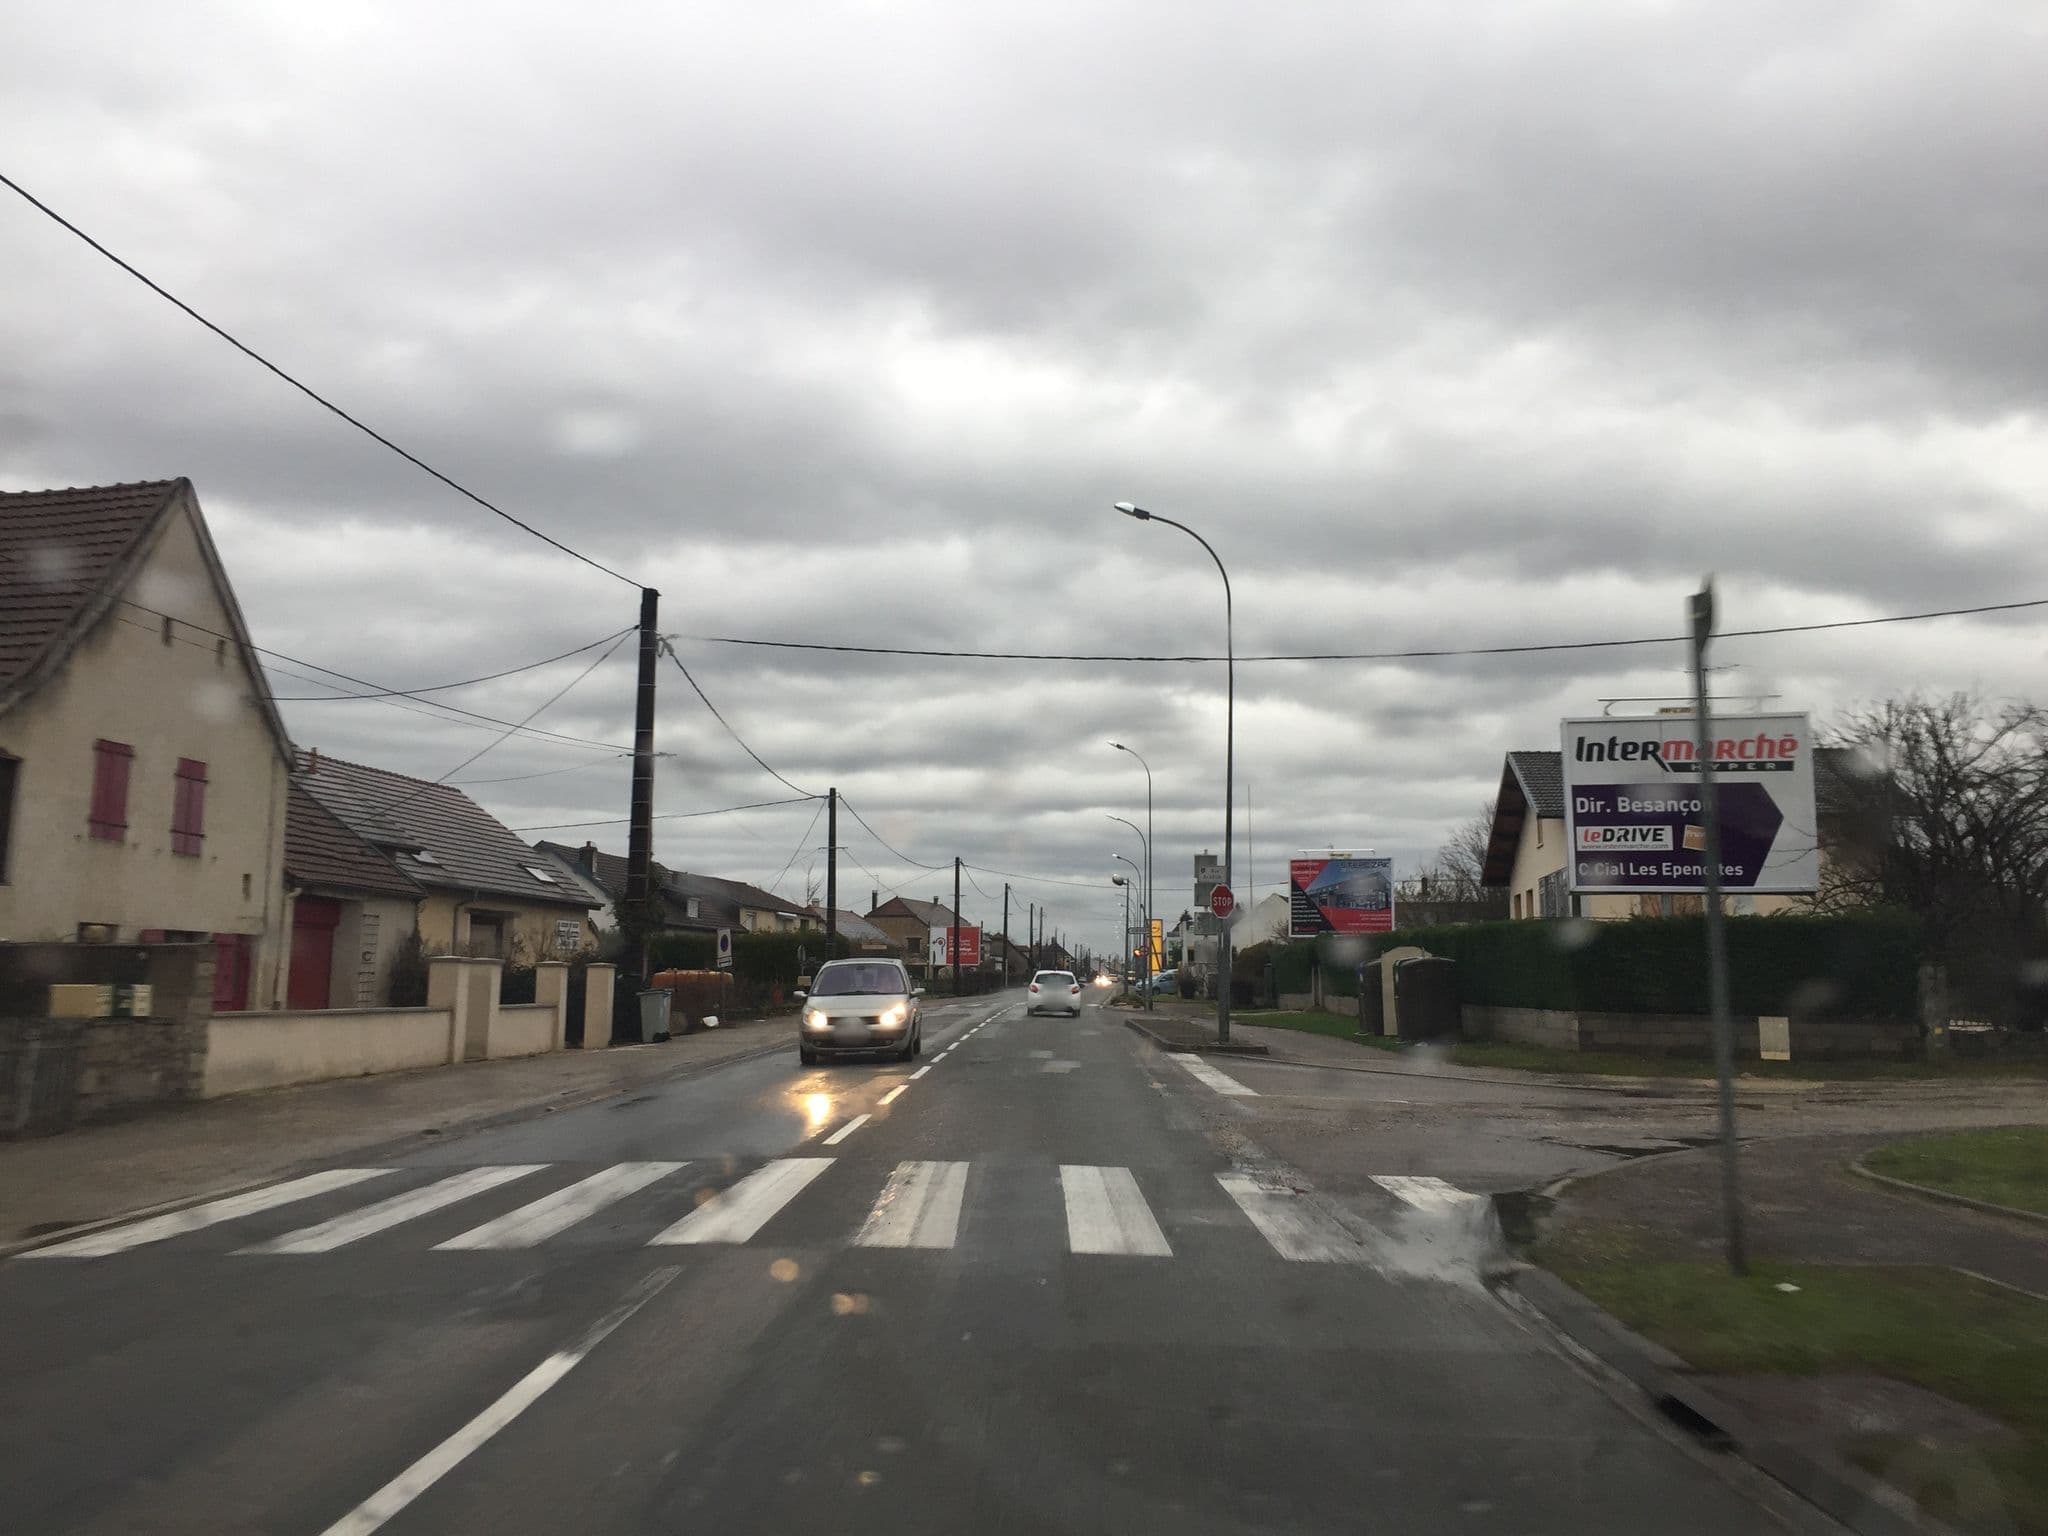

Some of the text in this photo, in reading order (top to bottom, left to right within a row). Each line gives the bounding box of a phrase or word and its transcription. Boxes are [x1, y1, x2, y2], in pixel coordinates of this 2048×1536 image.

[1576, 797, 1612, 813] Dir.
[1629, 863, 1657, 876] Les
[1212, 896, 1233, 906] STOP
